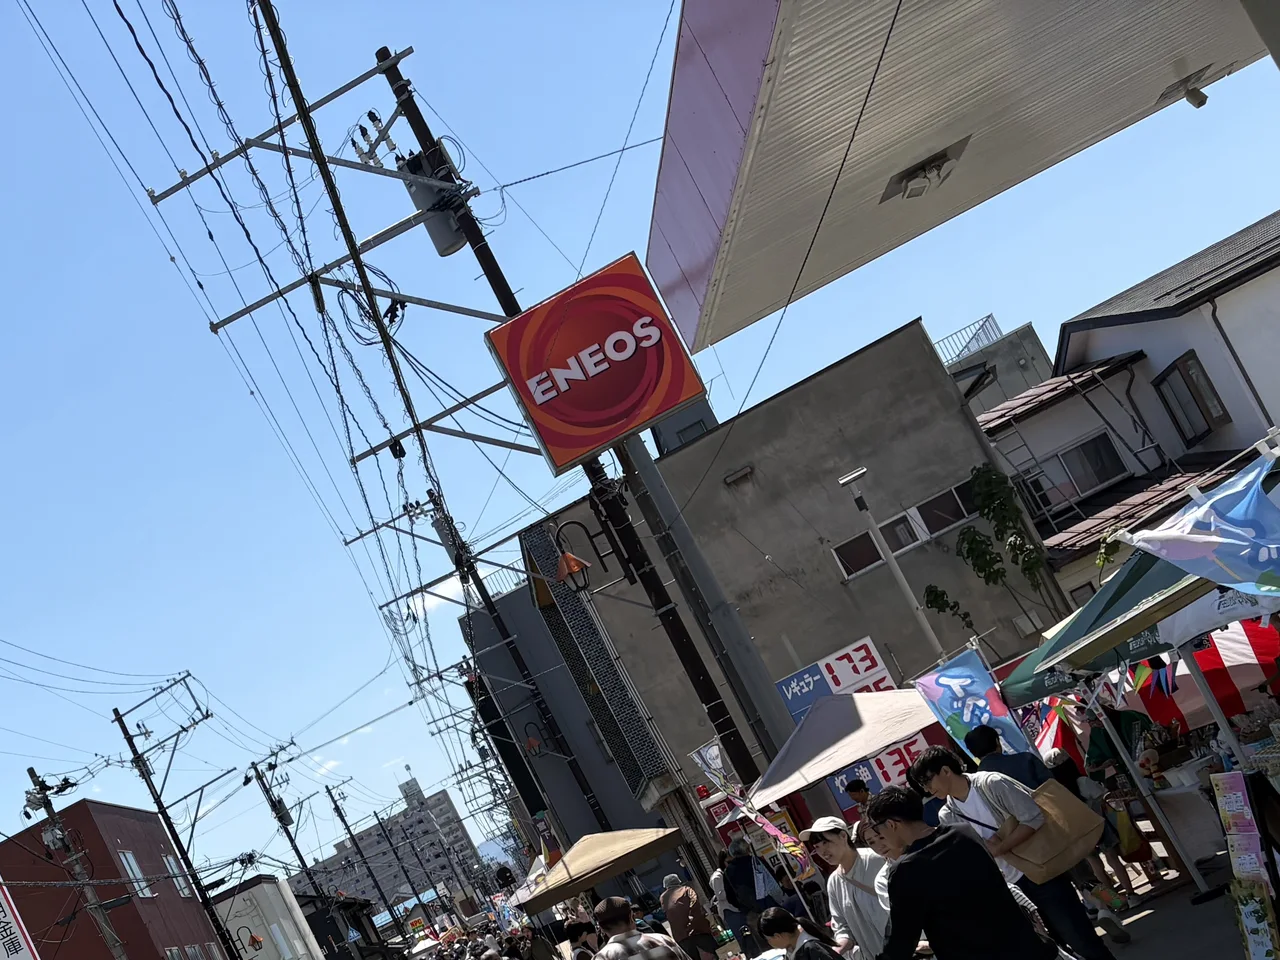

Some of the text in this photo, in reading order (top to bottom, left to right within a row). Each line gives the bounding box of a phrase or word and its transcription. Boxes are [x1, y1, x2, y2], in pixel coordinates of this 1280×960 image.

[525, 316, 663, 406] ENEOS
[824, 643, 879, 687] 173
[782, 673, 821, 700] レギュラー
[834, 764, 873, 794] 灯油
